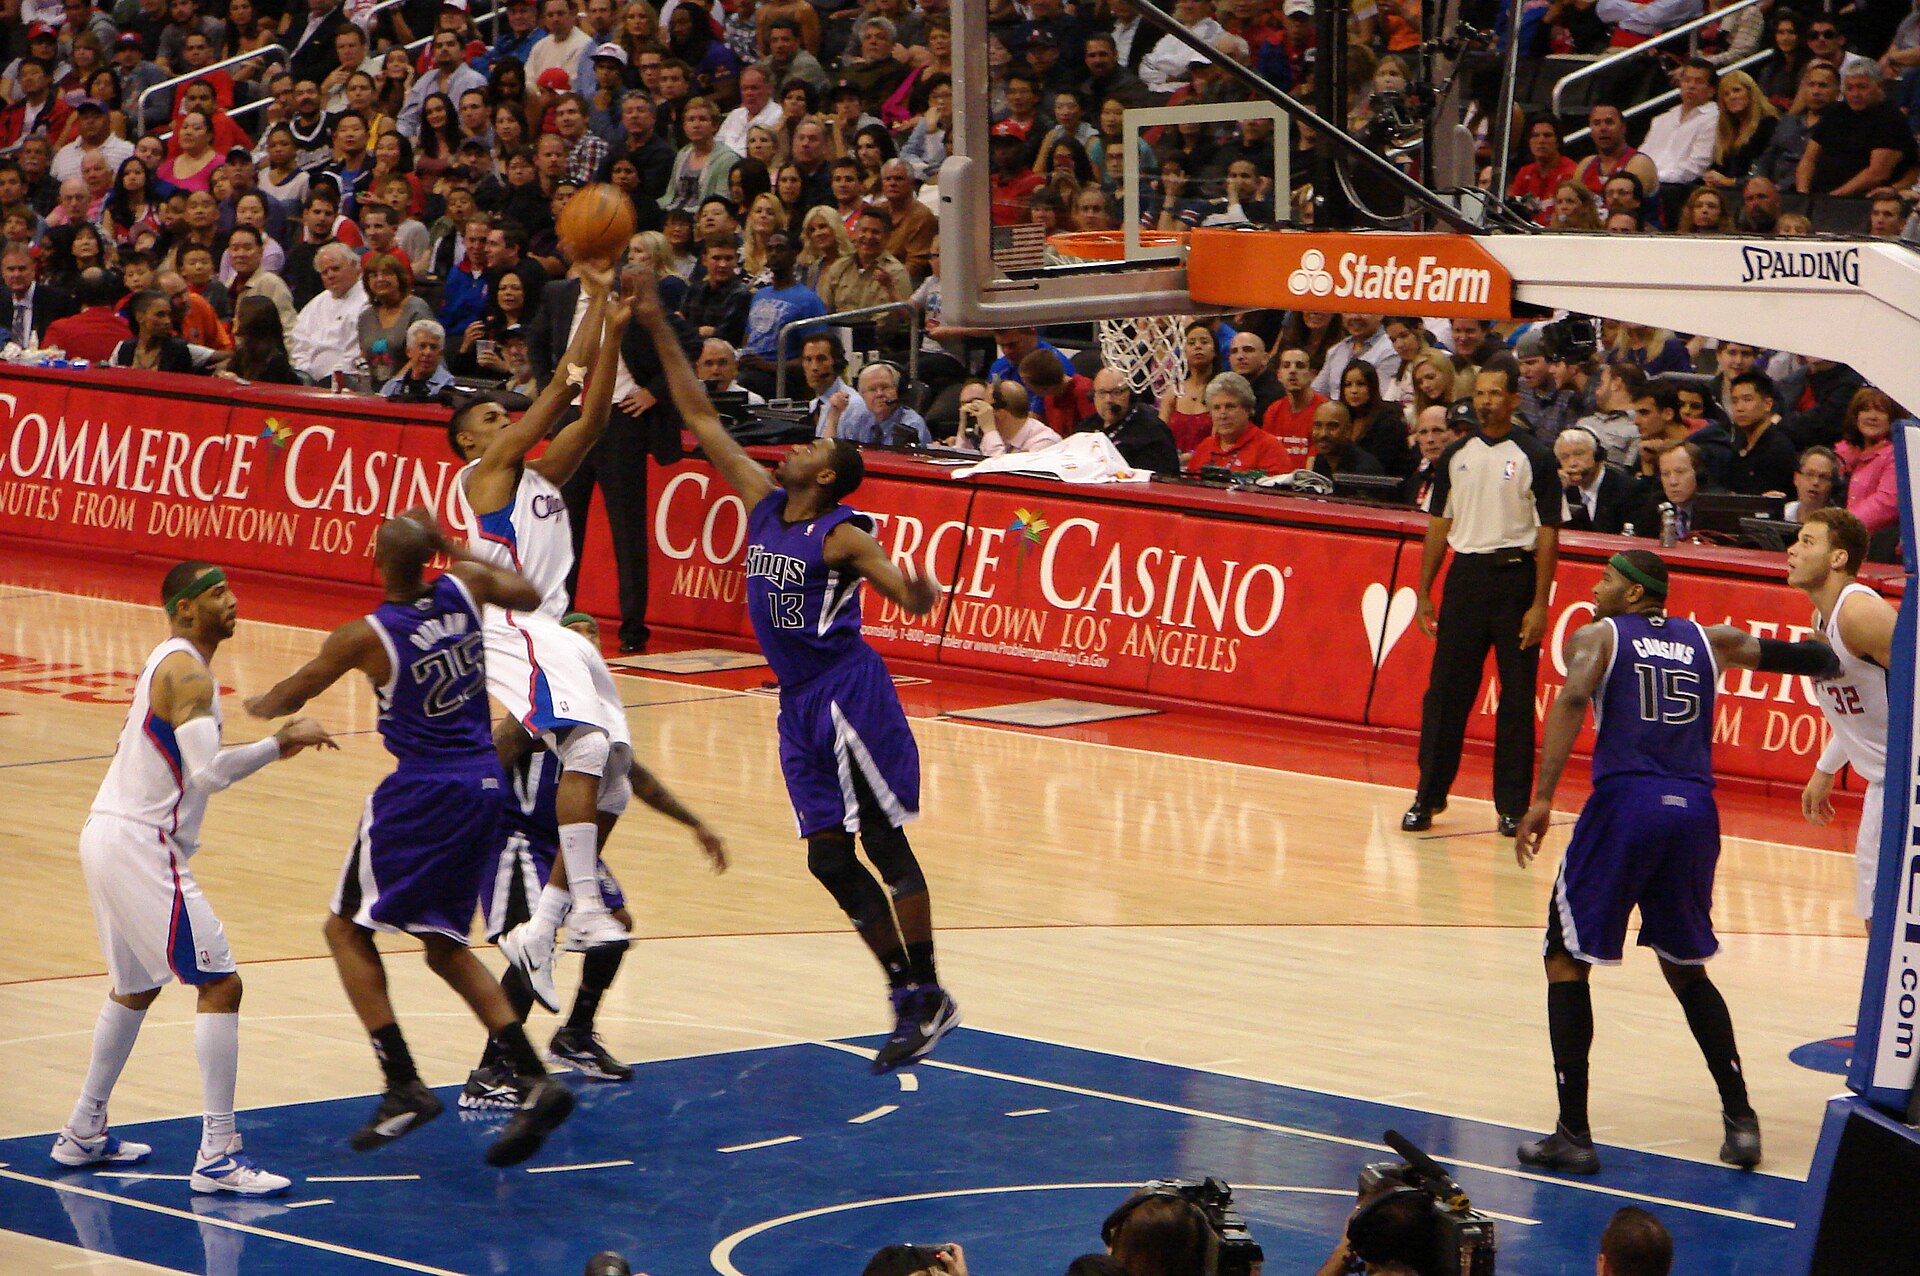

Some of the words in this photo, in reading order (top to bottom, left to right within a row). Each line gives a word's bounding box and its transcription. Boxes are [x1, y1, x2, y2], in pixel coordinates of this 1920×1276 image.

[1742, 245, 1859, 286] SPALDING
[0, 393, 258, 502] OMMERCE
[71, 490, 137, 532] FROM
[147, 501, 299, 547] DOWNTOWN
[310, 516, 357, 556] LOS
[768, 592, 804, 629] 13
[1060, 613, 1112, 654] LOS
[1119, 622, 1242, 674] ANGELES
[1633, 662, 1700, 725] 15
[1826, 685, 1865, 715] 32
